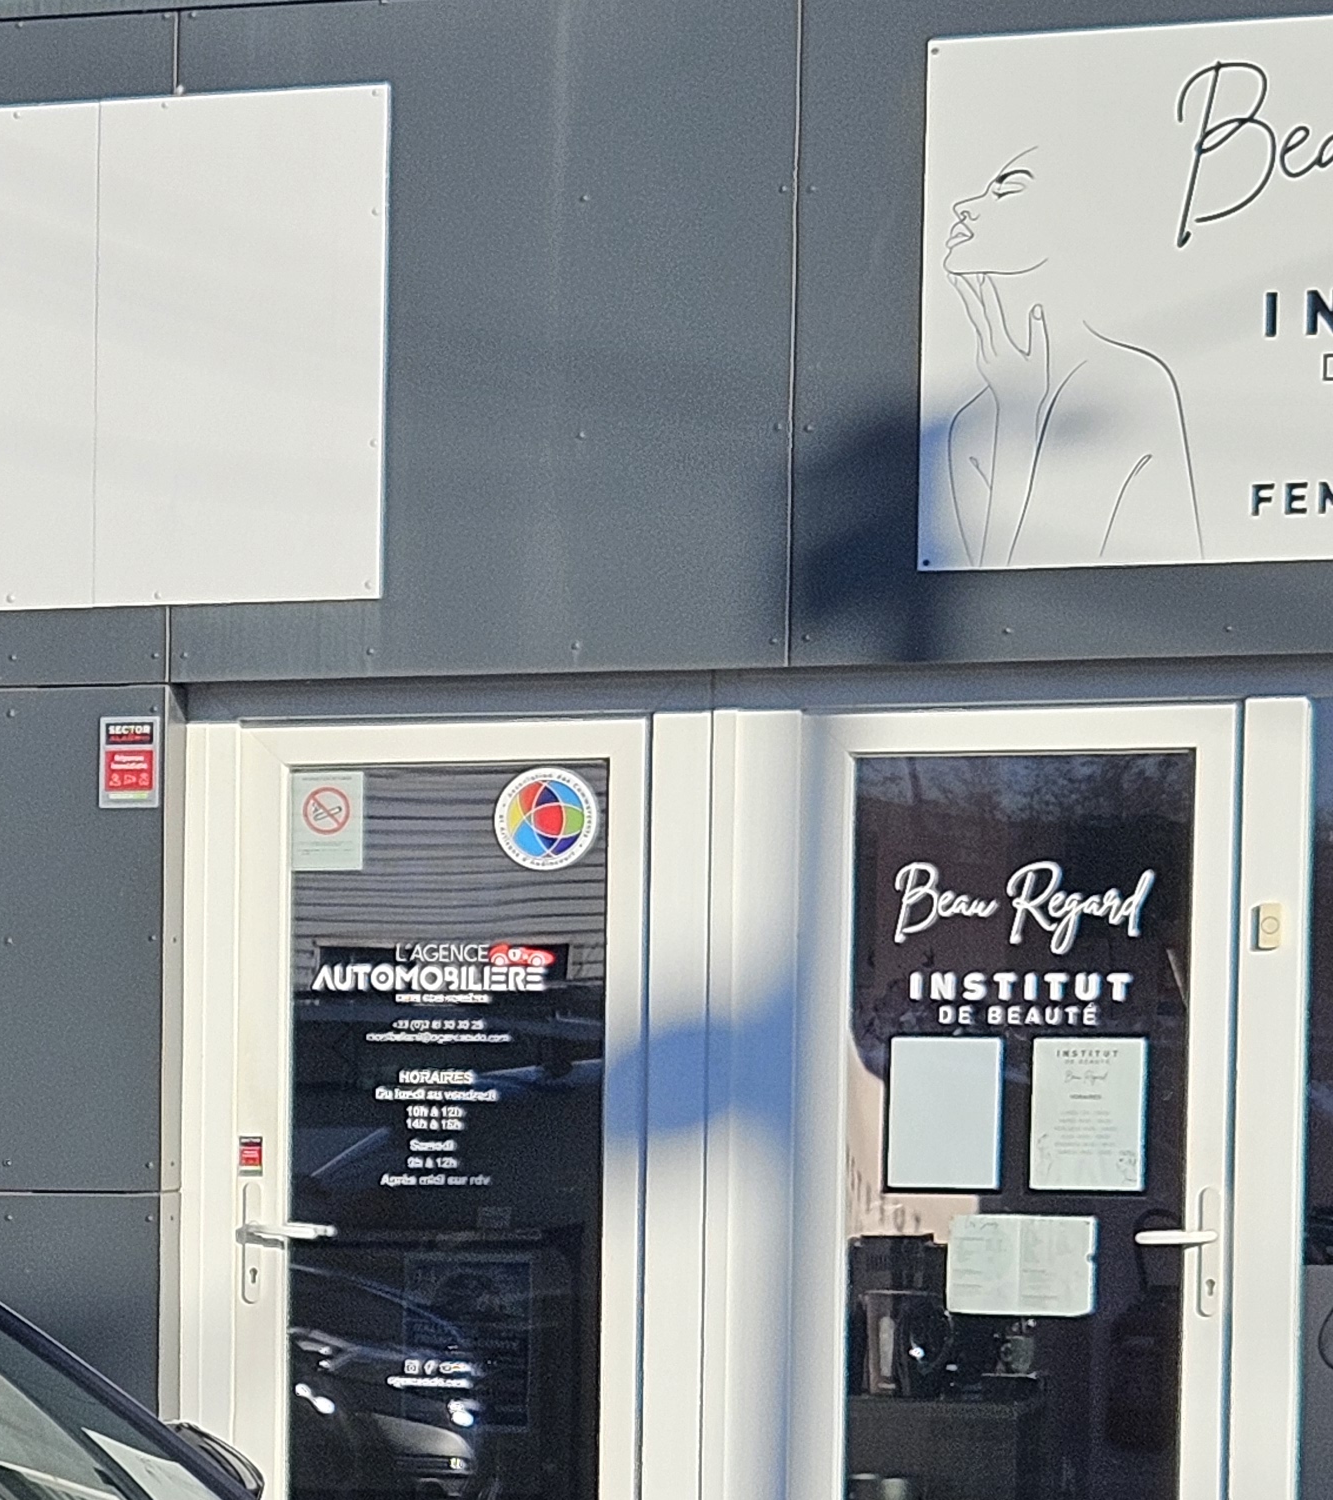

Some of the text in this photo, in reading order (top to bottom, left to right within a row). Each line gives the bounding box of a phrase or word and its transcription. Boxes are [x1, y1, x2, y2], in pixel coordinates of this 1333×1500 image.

[894, 859, 1157, 956] Beau Regard
[394, 942, 491, 963] L'AGENCE
[908, 970, 1135, 1003] INSTITUT
[937, 1001, 1100, 1026] DE BEAUTÉ
[1056, 1049, 1119, 1058] INSTITUT
[398, 1068, 474, 1085] HORAIRES
